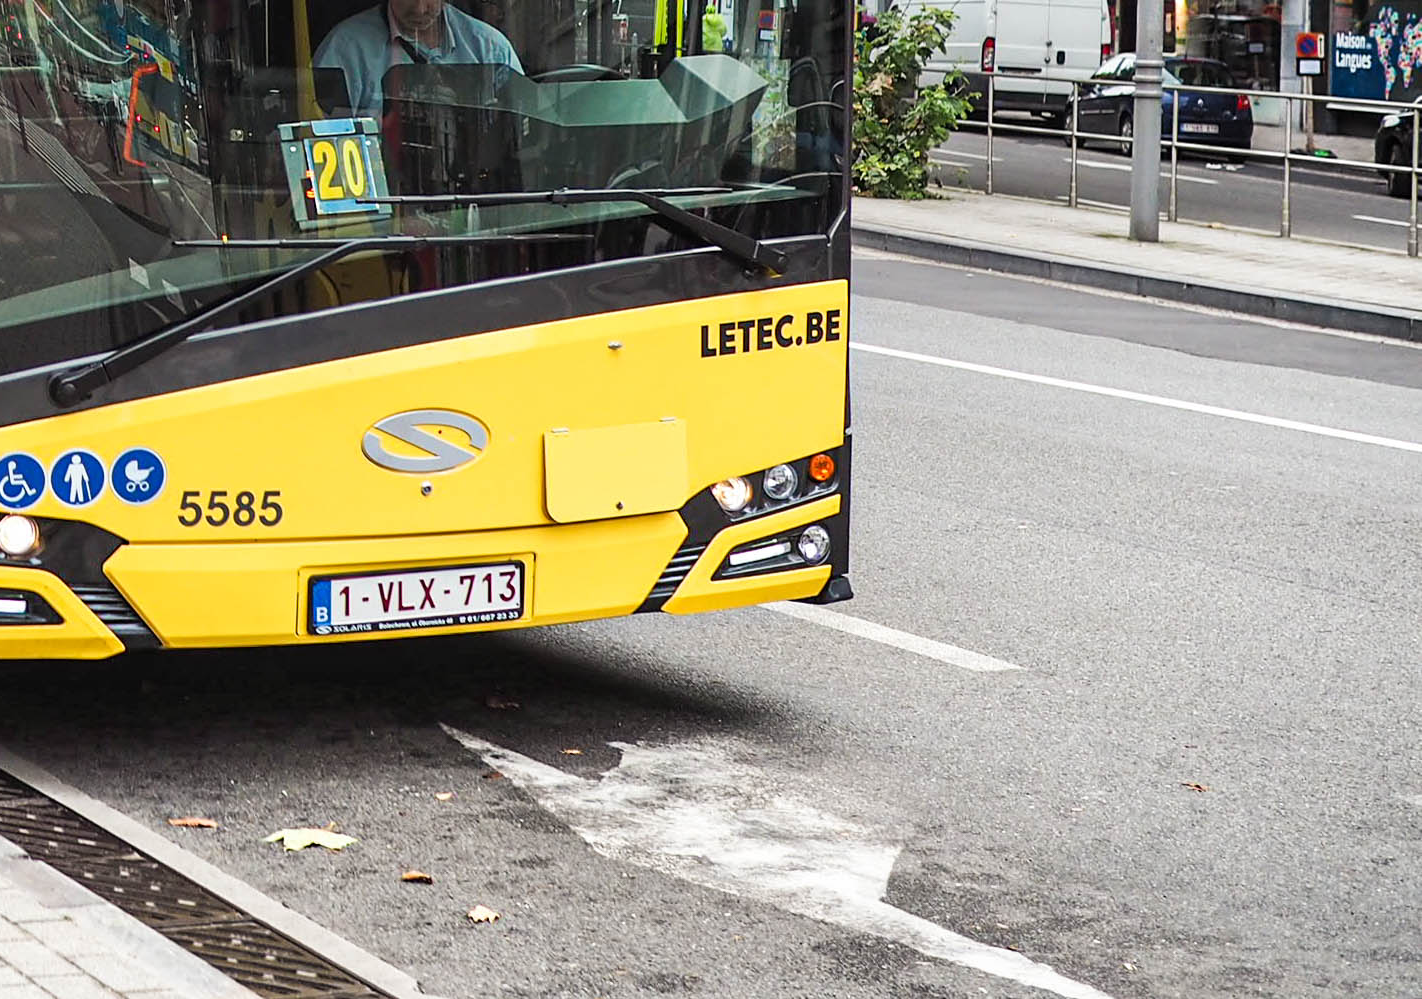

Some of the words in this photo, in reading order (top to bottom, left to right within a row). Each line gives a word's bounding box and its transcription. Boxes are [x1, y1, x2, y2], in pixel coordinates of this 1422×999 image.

[1336, 31, 1366, 49] Maison
[1335, 49, 1372, 73] Langues
[312, 139, 365, 200] 20
[700, 308, 841, 359] LETEC.BE
[177, 490, 284, 528] 5585
[315, 606, 329, 623] B
[333, 623, 372, 633] SOLARIS
